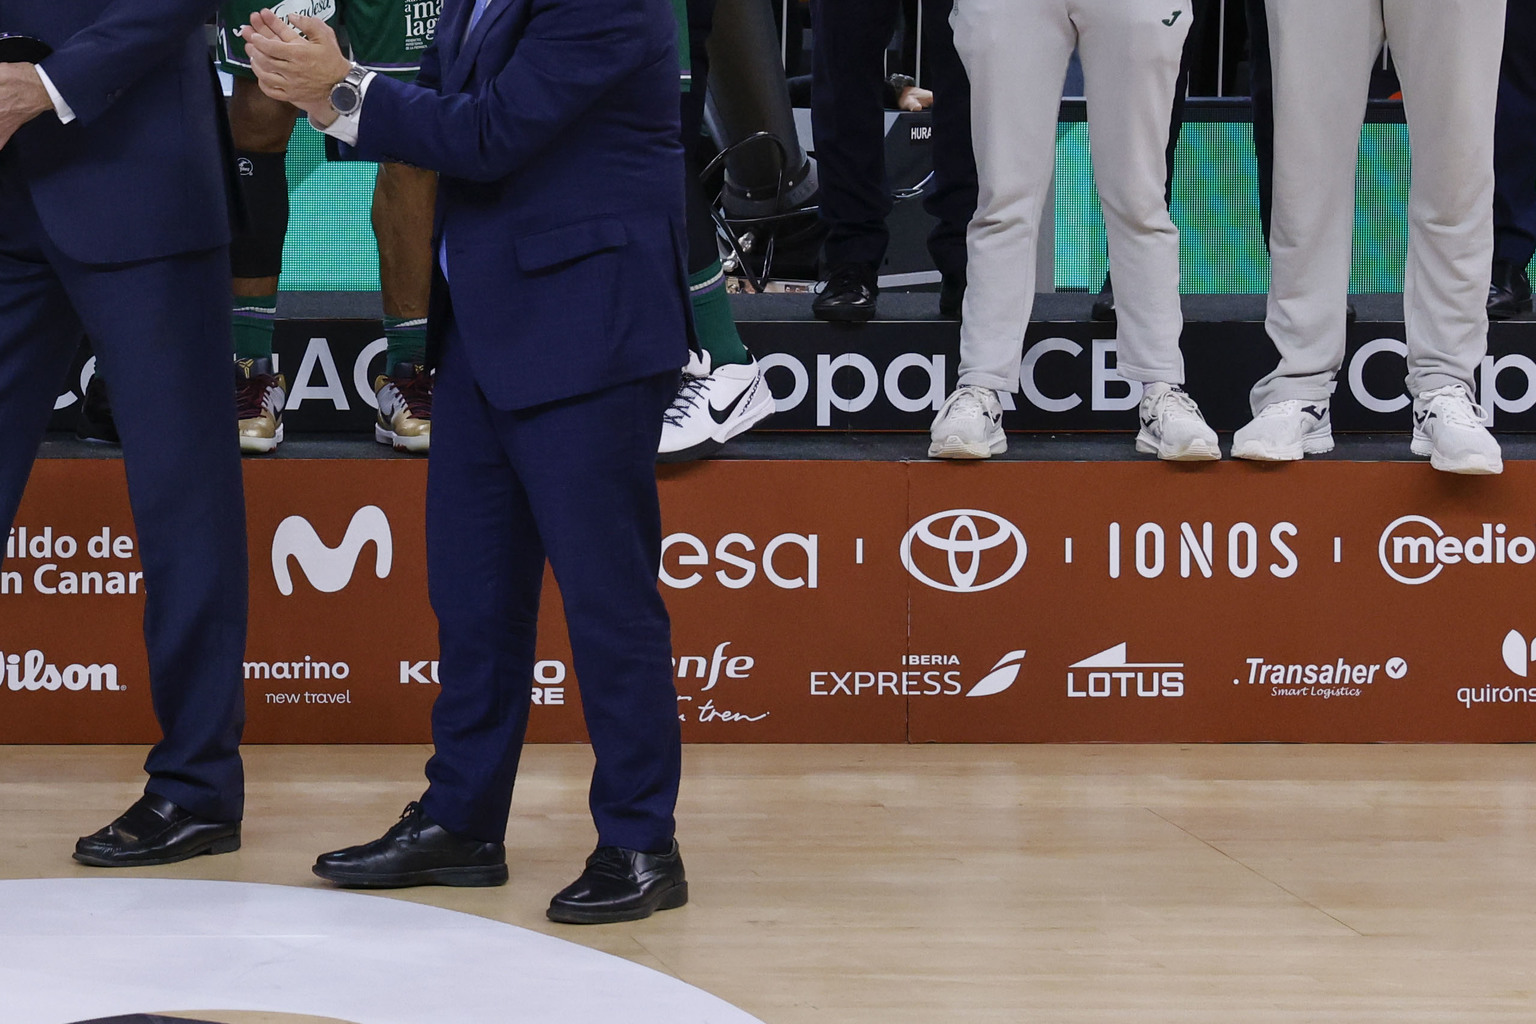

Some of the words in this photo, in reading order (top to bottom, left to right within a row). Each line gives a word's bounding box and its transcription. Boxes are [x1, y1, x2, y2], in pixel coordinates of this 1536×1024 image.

[405, 15, 440, 40] lag
[7, 527, 77, 558] ildo
[87, 527, 134, 558] de
[1109, 521, 1298, 579] IONOS
[1393, 523, 1536, 564] medio
[658, 532, 818, 589] esa
[34, 564, 147, 594] Canar
[241, 656, 350, 681] marino
[672, 641, 754, 692] nfe
[902, 655, 960, 666] IBERIA
[1246, 657, 1380, 684] Transaher
[531, 687, 565, 705] RE
[810, 671, 961, 696] EXPRESS
[1067, 672, 1185, 697] LOTUS
[1271, 686, 1308, 697] Smart
[1310, 686, 1362, 699] Logistics
[265, 692, 302, 704] new
[305, 689, 352, 704] travel
[698, 699, 766, 723] tren
